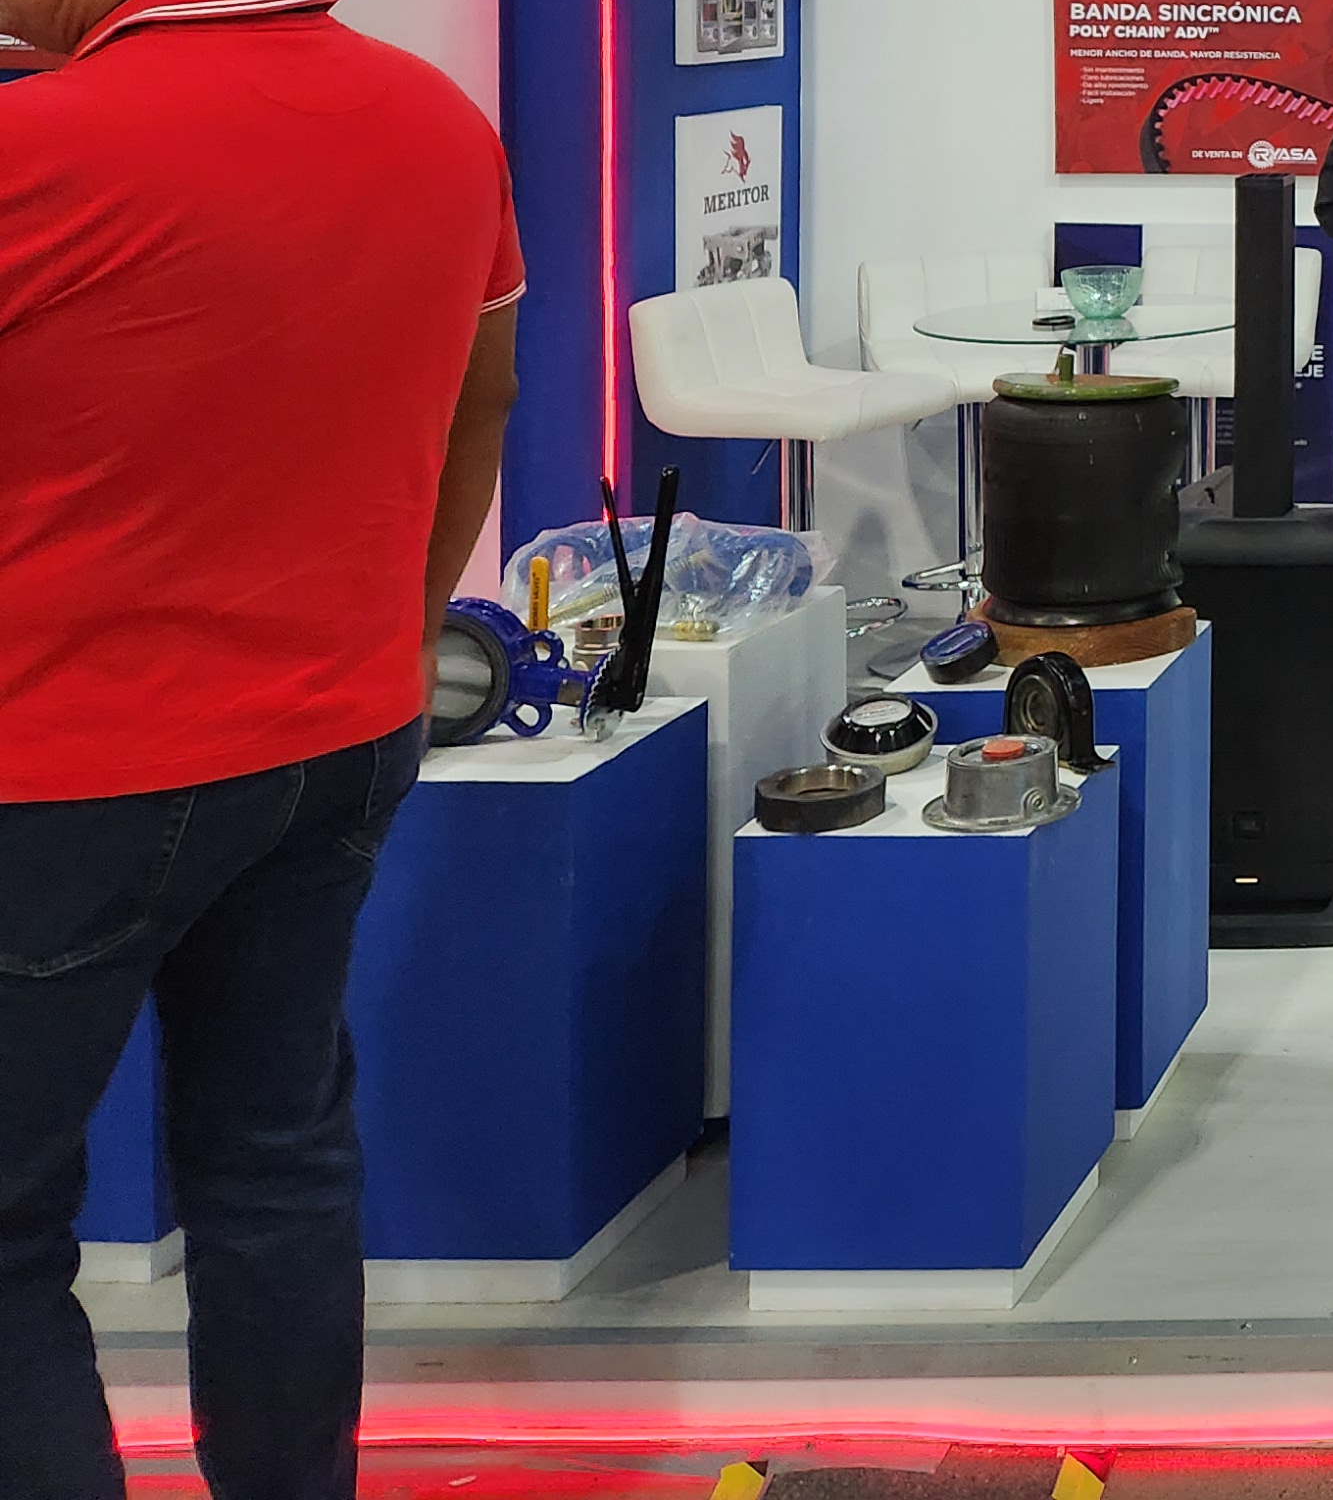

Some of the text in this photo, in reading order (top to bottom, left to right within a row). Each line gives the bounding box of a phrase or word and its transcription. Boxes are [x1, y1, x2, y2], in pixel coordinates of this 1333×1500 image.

[1070, 1, 1301, 23] BANDA SINCRÓNICA
[1070, 26, 1109, 38] POLY
[1070, 49, 1103, 57] MENOR
[1105, 50, 1137, 58] ANCHO
[1140, 50, 1152, 58] DE
[1190, 51, 1222, 59] MAYOR
[1224, 52, 1280, 60] RESISTENCIA
[1192, 147, 1317, 167] DE VENTA RYASA
[704, 185, 769, 214] MERITOR
